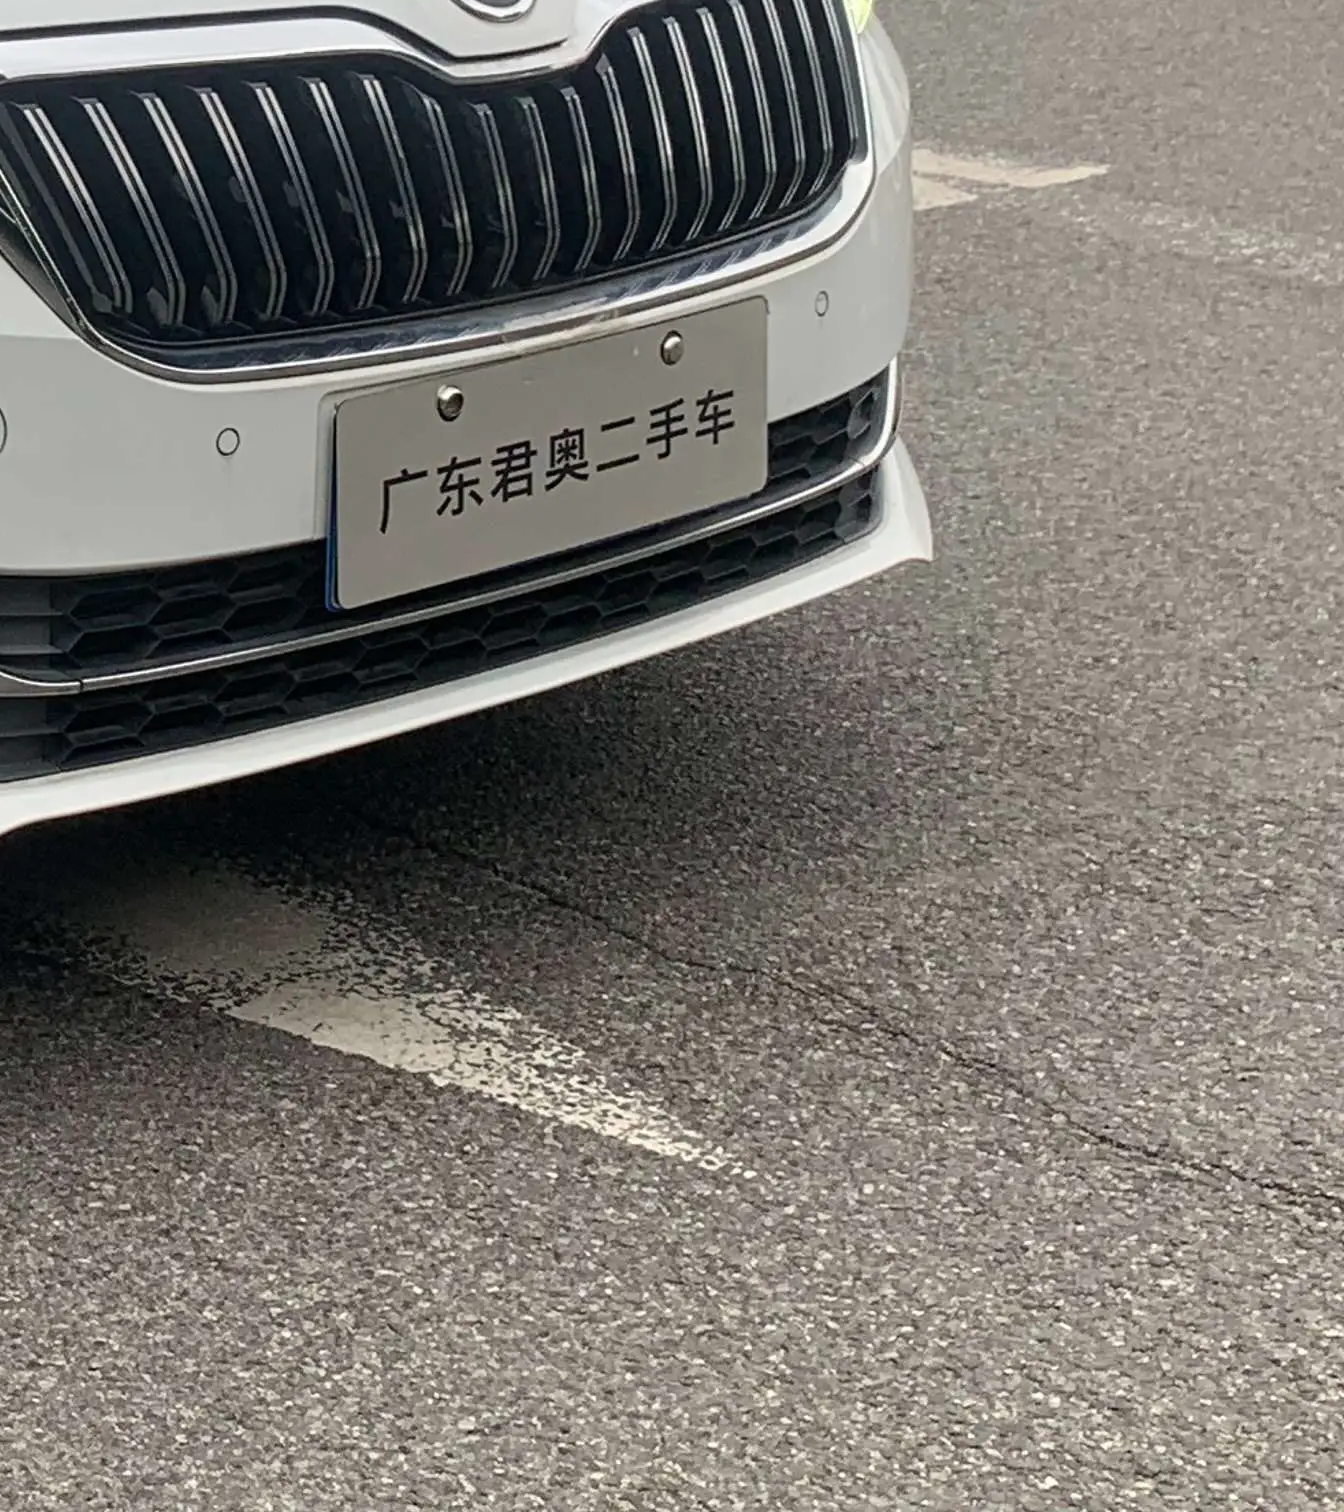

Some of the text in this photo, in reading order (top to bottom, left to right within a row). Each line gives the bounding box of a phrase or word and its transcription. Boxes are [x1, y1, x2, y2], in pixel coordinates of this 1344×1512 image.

[378, 388, 736, 535] 广东君奥二手车
